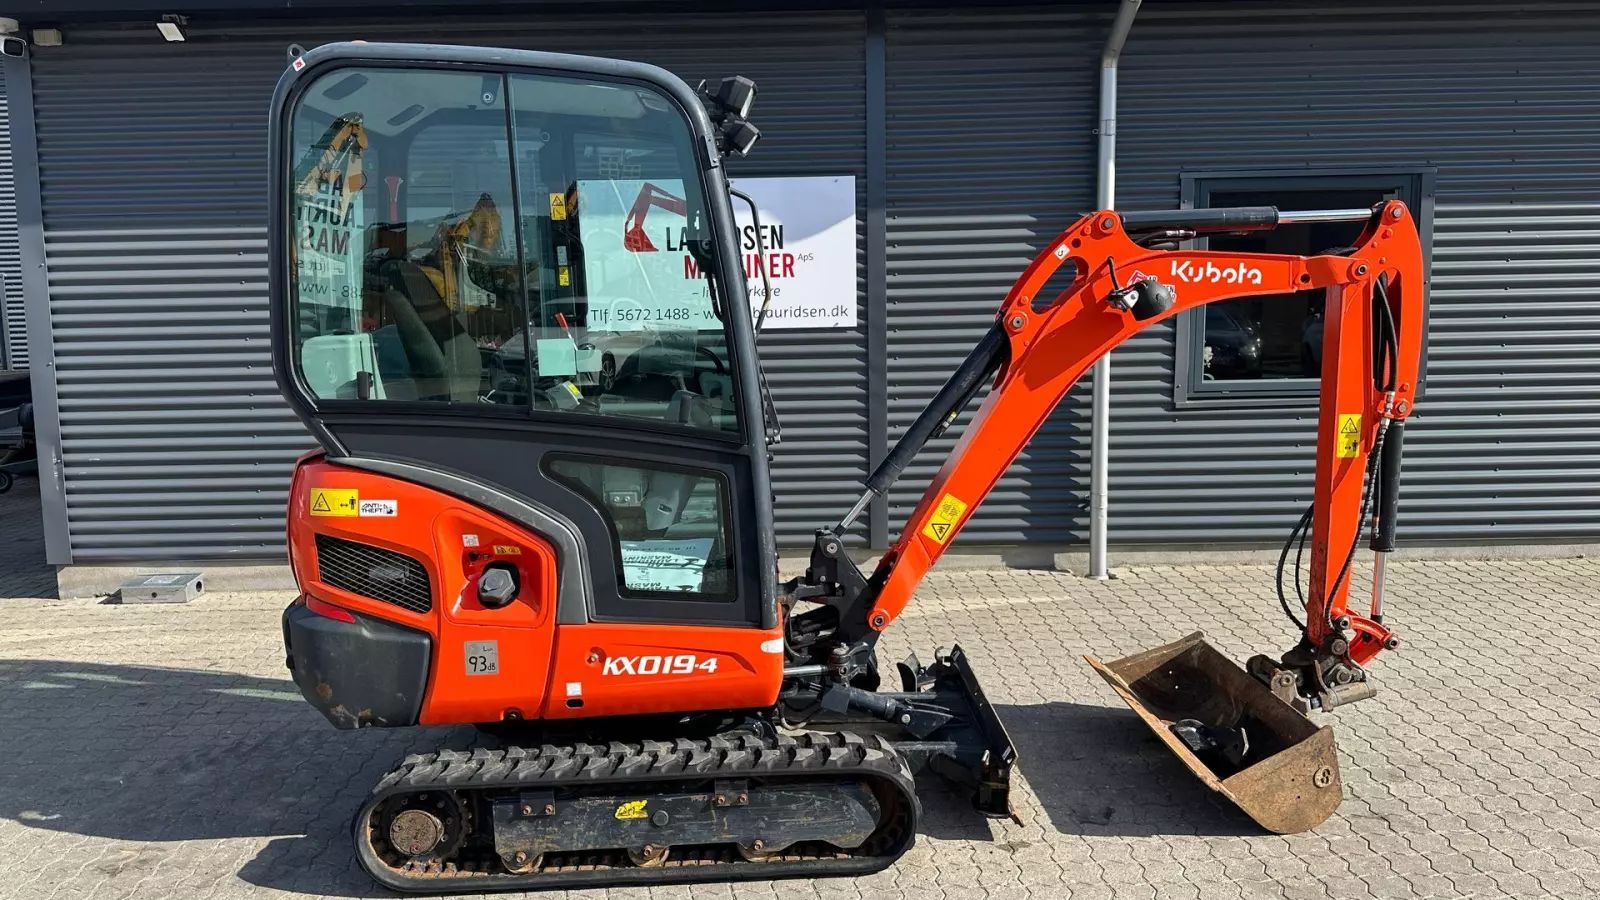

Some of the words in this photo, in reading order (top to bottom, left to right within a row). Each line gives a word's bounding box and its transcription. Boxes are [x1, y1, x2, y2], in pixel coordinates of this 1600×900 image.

[798, 253, 814, 262] ApS
[1171, 260, 1263, 284] Kubota
[590, 309, 612, 324] Tlf.
[617, 309, 651, 321] 5672
[655, 308, 690, 320] 1488
[468, 655, 487, 672] 93
[487, 662, 496, 671] dB
[602, 655, 718, 676] KX019-4
